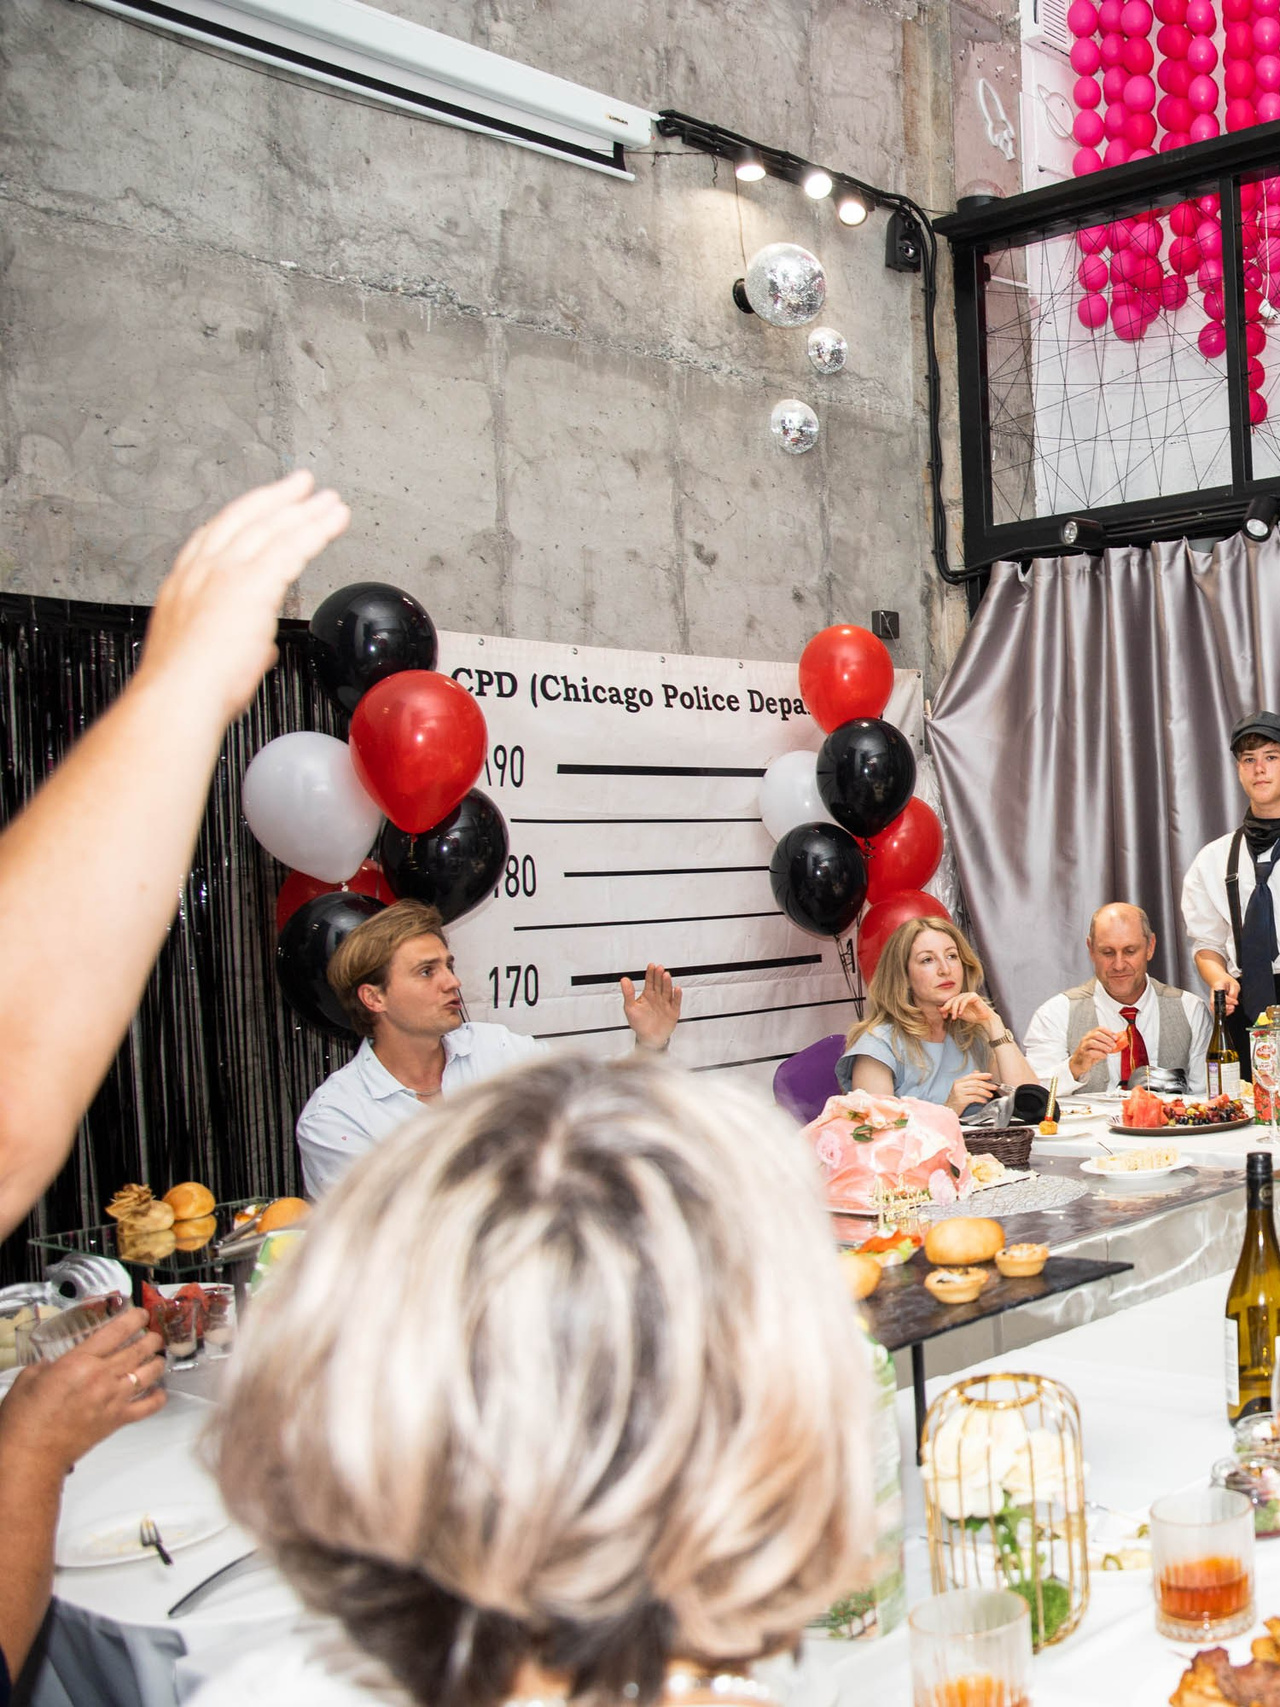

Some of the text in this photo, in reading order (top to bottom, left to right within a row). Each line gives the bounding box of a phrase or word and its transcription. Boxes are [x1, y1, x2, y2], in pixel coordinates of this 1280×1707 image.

[451, 667, 811, 721] CPD (Chicago Police Depa
[489, 964, 539, 1009] 170
